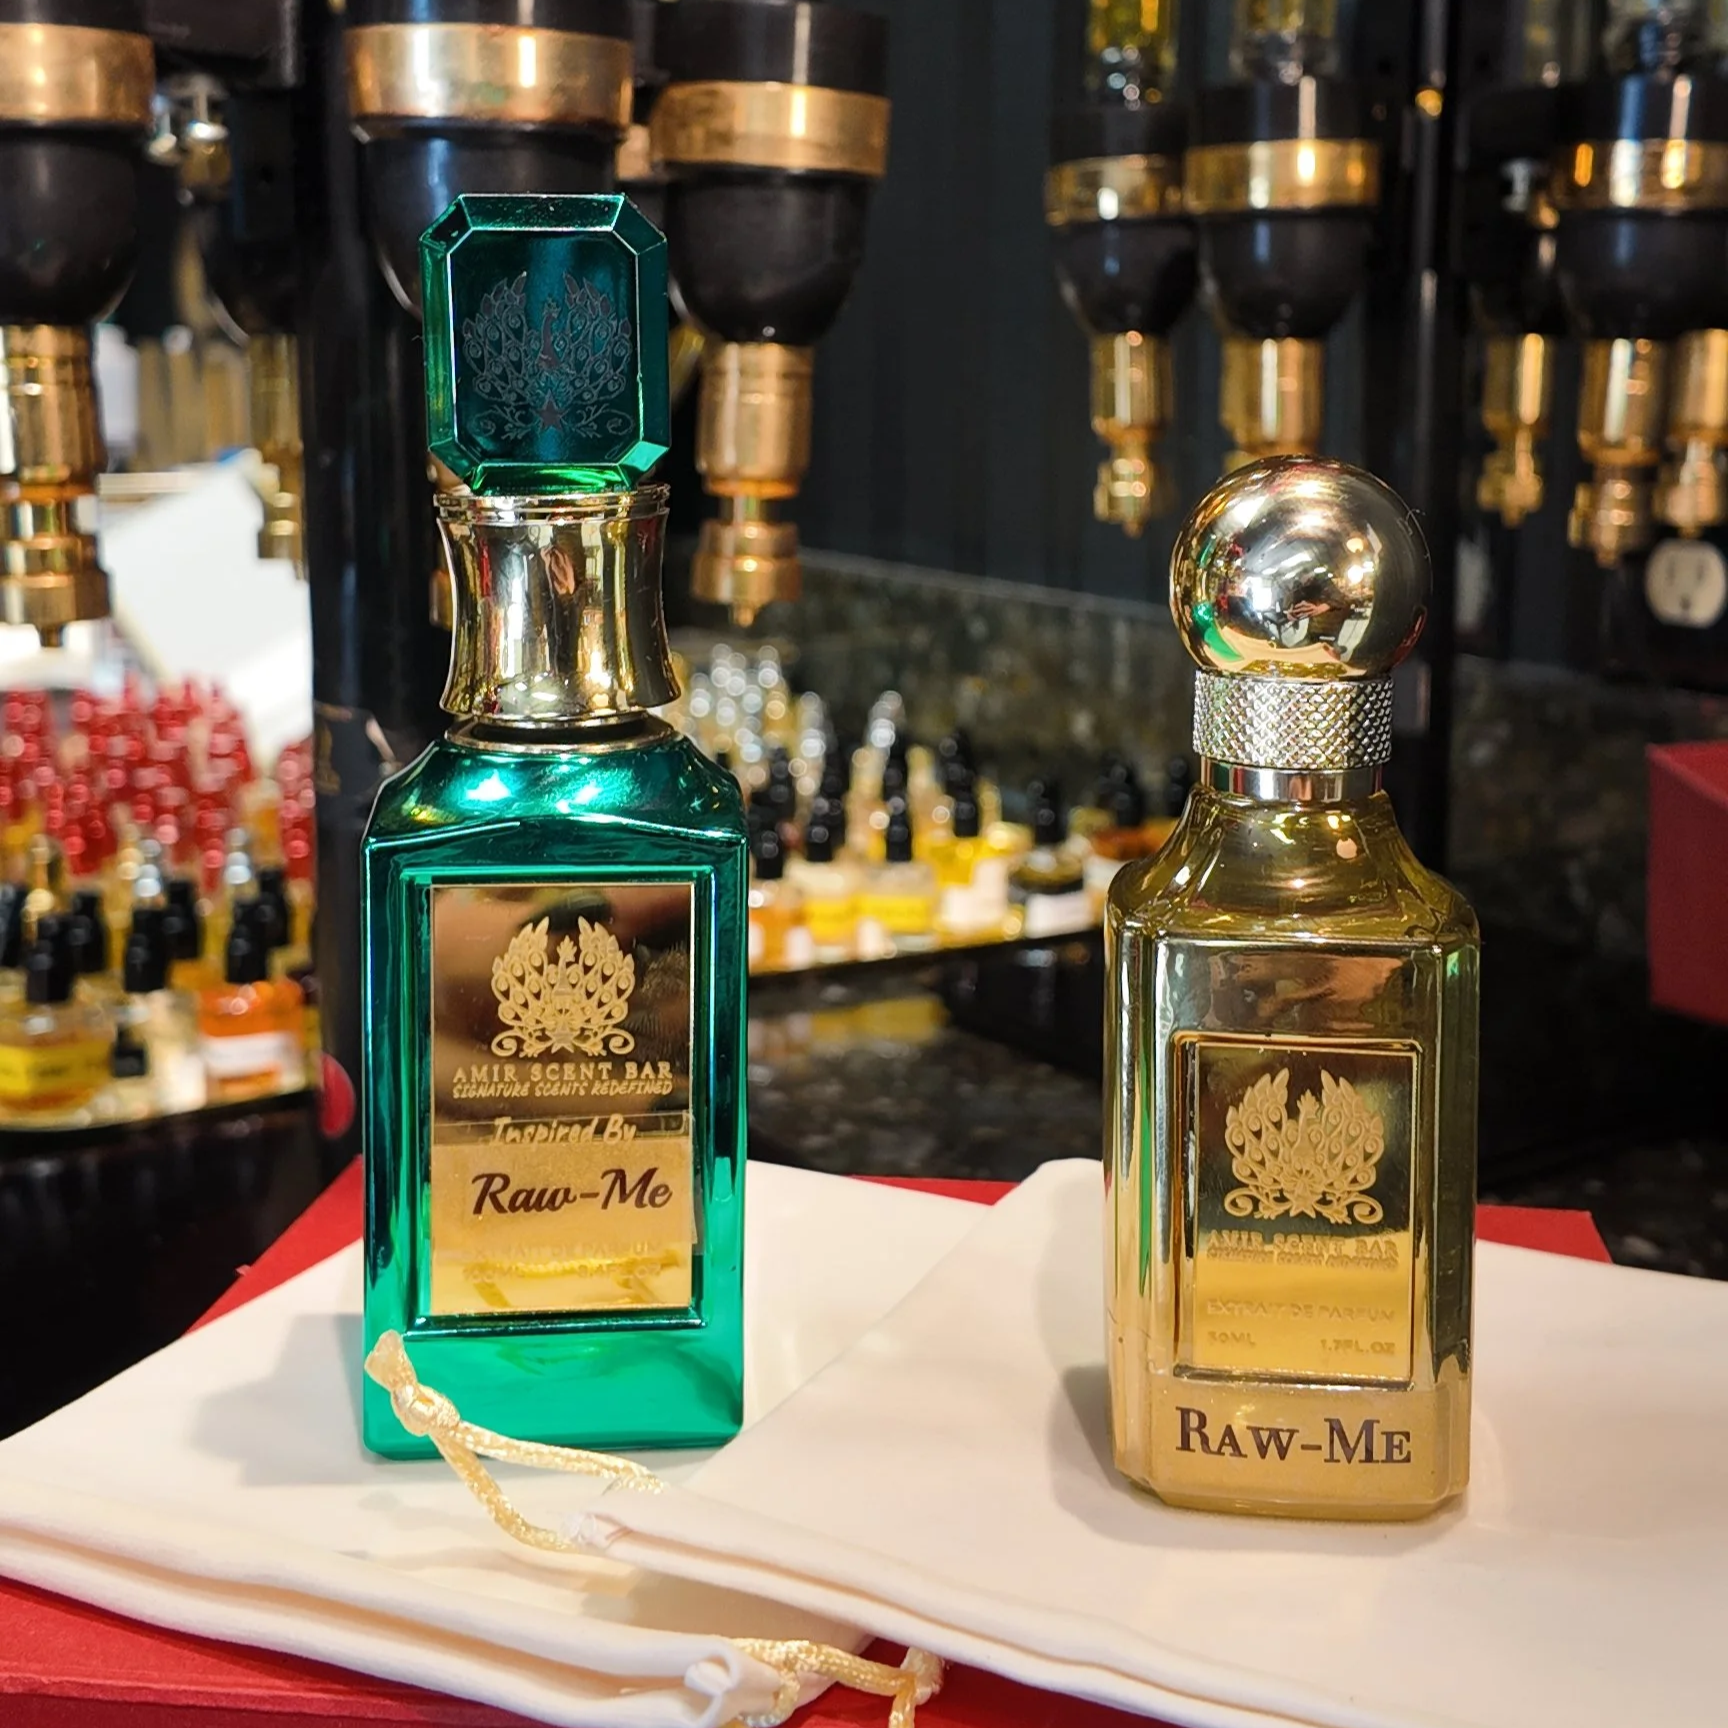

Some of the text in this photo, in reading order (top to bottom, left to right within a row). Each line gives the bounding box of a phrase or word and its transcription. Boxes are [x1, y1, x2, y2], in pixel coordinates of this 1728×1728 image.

[453, 1061, 673, 1082] AMIR SCENT BAR
[453, 1080, 673, 1098] SIGNATURE SCENTS REDEFINED
[492, 1113, 637, 1145] Inspired By
[471, 1167, 673, 1215] Raw-Me
[1207, 1229, 1264, 1250] AMIR
[1272, 1232, 1345, 1254] SCENT
[1355, 1238, 1398, 1258] BAR
[1290, 1302, 1314, 1319] DE
[1175, 1406, 1412, 1464] RAW-ME
